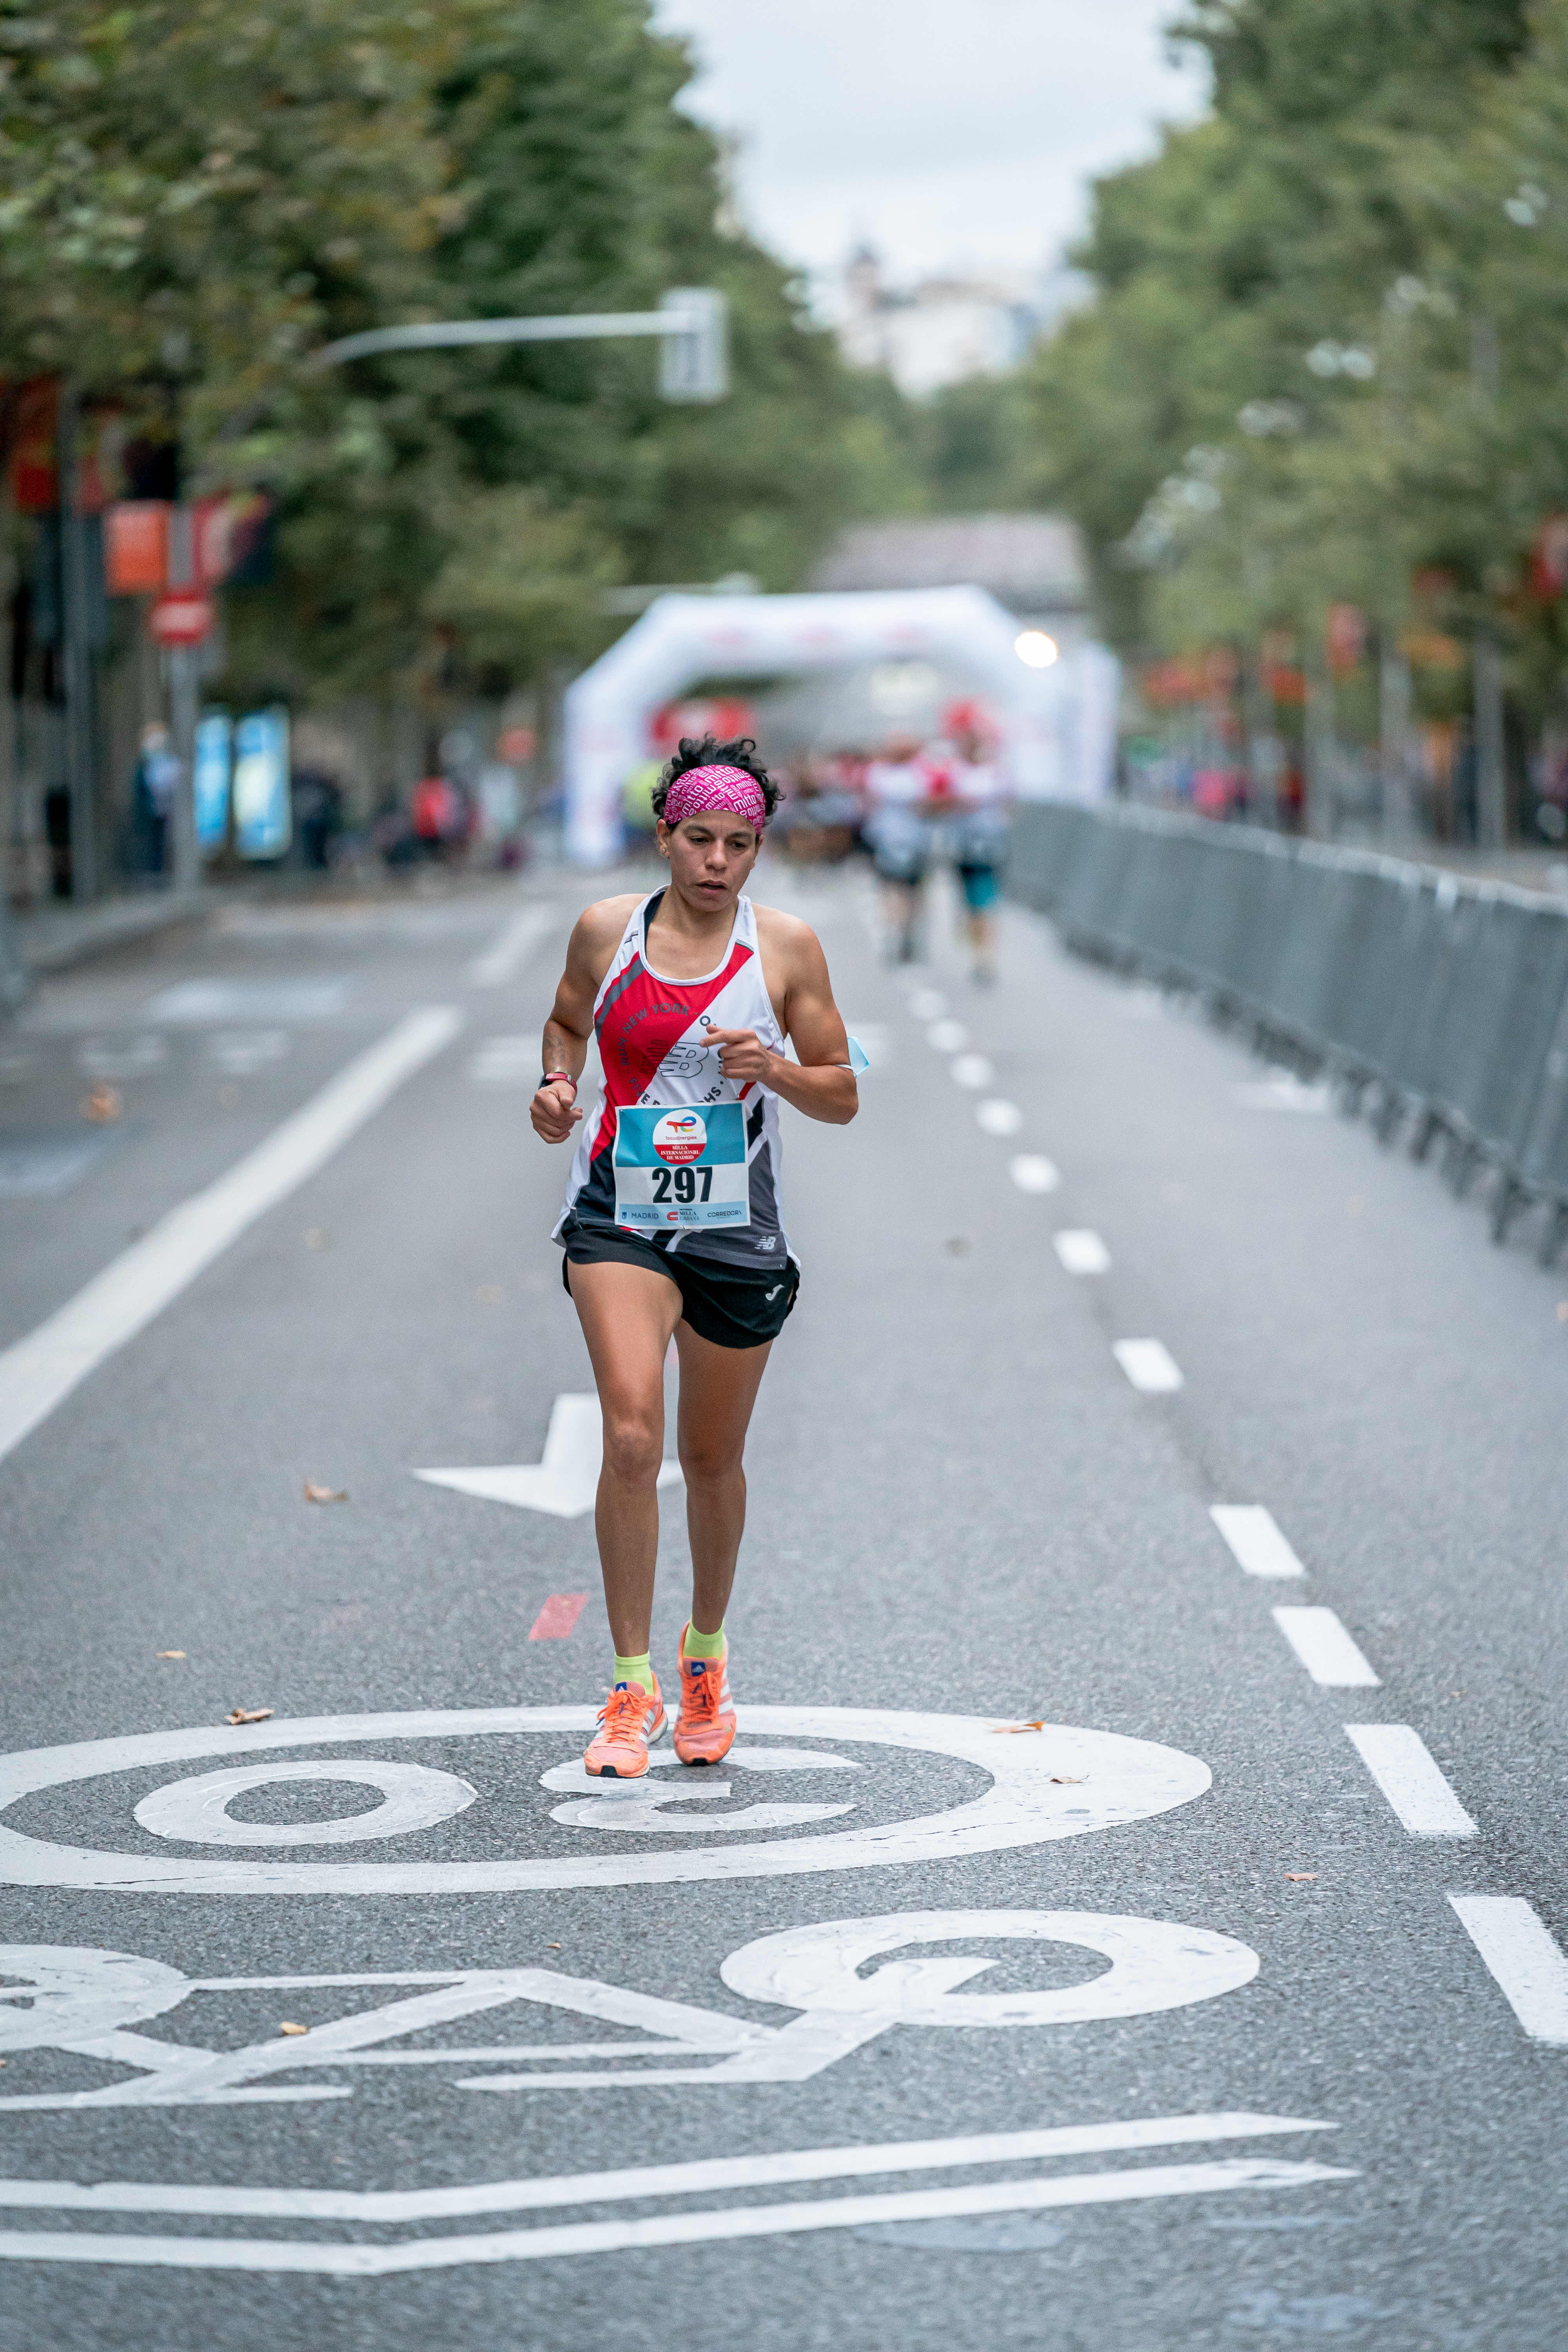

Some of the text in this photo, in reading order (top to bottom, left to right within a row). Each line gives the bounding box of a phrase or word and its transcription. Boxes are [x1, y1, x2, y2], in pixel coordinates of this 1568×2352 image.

[705, 766, 734, 784] mitto
[682, 785, 704, 815] mitto
[693, 784, 717, 809] mitto
[705, 792, 725, 809] mitto
[713, 780, 739, 800] mitto
[733, 793, 757, 811] mitto
[618, 1003, 691, 1065] RUN NEW YORK
[652, 1166, 713, 1203] 297
